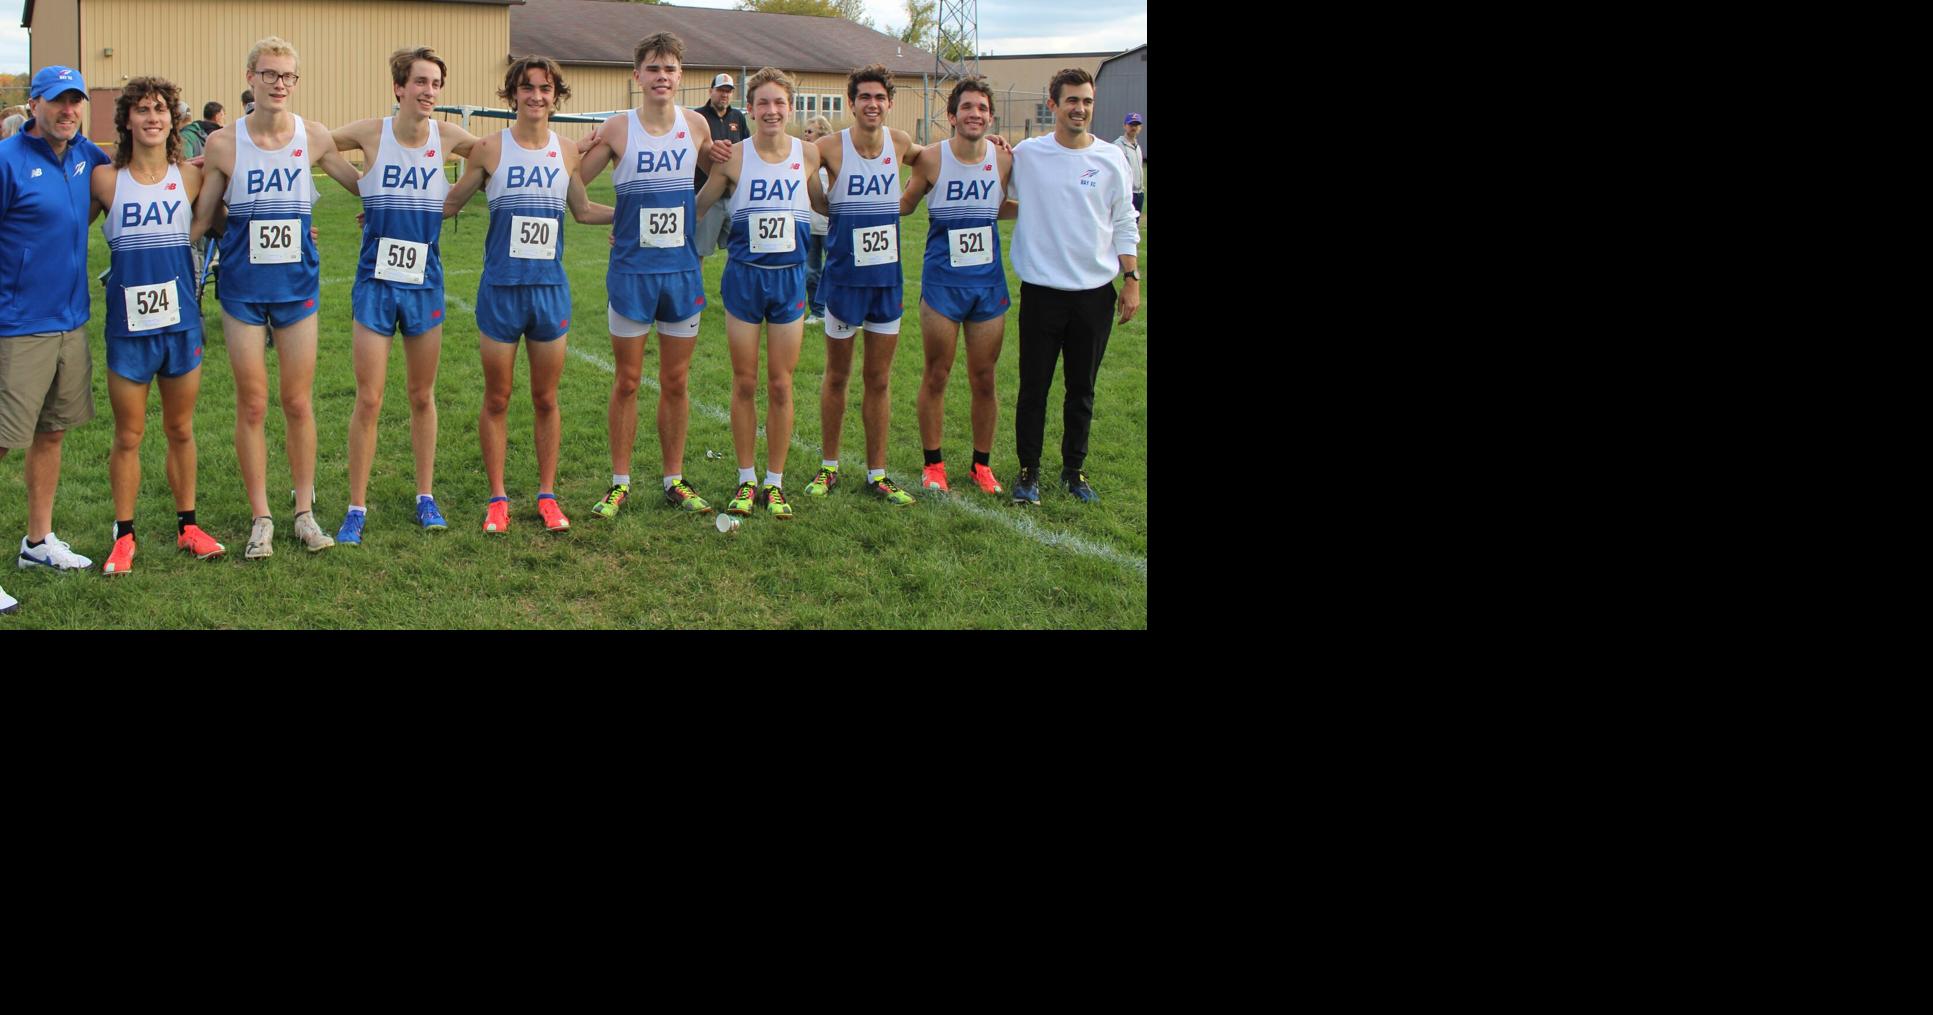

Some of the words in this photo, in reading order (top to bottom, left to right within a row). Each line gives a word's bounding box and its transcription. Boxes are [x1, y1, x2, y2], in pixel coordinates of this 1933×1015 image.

[637, 149, 687, 173] BAY
[248, 168, 302, 194] BAY
[382, 165, 437, 190] BAY
[507, 166, 559, 188] BAY
[848, 174, 895, 195] BAY
[750, 179, 800, 200] BAY
[947, 180, 995, 200] BAY
[122, 200, 181, 228] BAY
[650, 213, 677, 234] 523
[260, 225, 292, 248] 526
[520, 222, 549, 244] 520
[759, 217, 785, 238] 527
[863, 230, 889, 252] 525
[960, 233, 984, 252] 521
[387, 244, 416, 268] 519
[137, 289, 169, 315] 524
